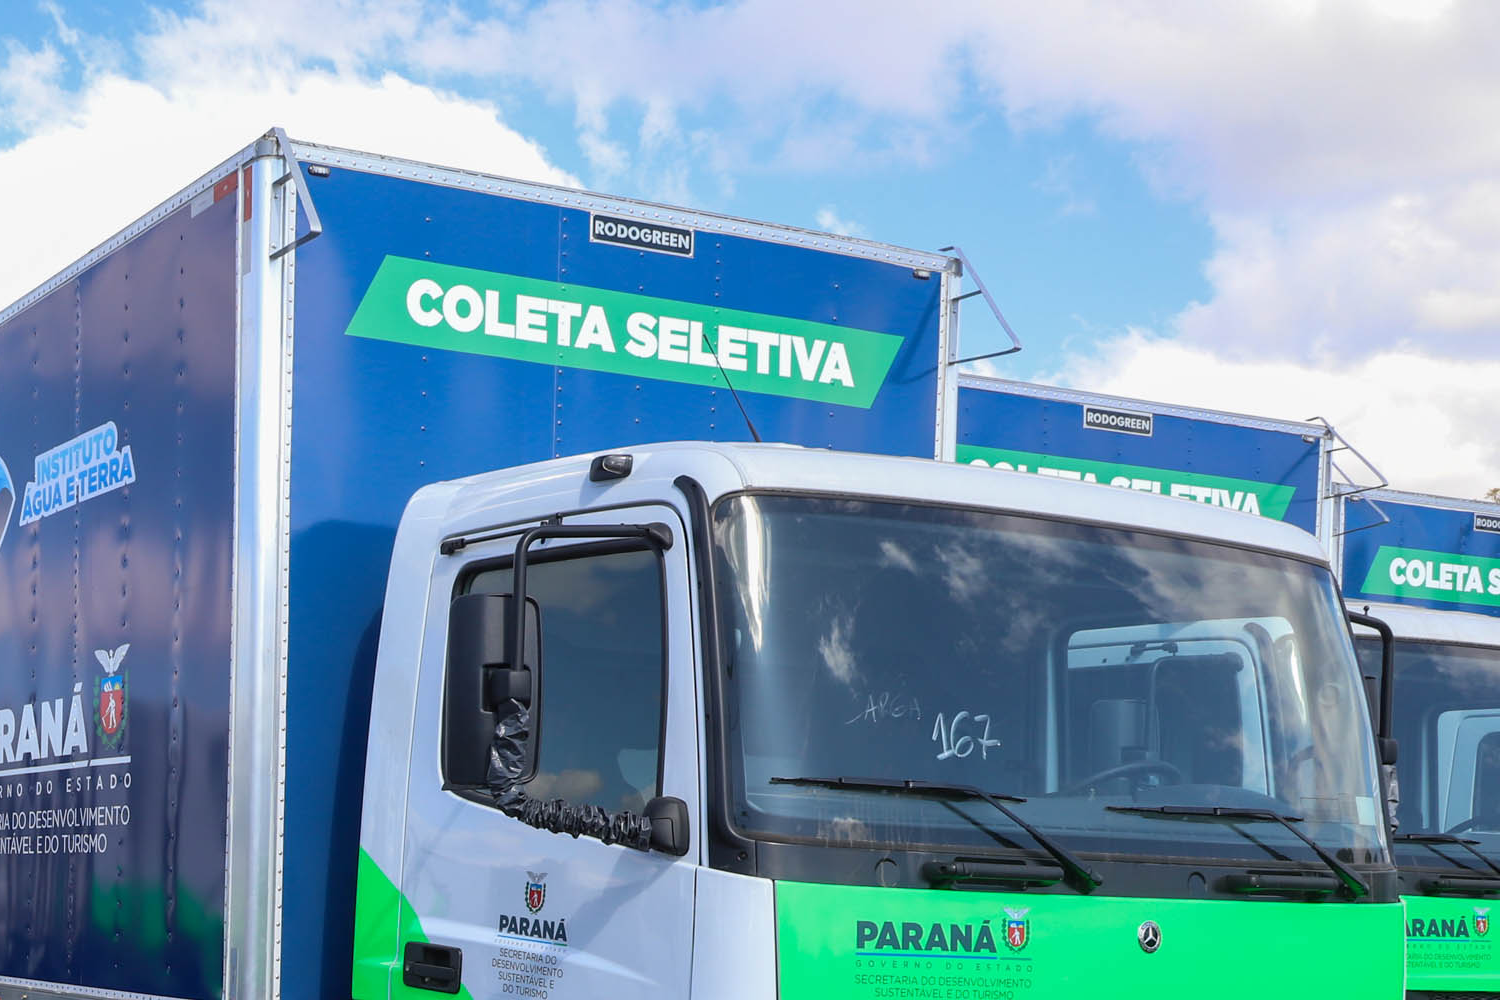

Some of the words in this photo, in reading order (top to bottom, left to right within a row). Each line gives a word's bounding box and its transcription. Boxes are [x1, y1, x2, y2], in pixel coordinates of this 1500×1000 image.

[594, 219, 690, 249] RODOGREEN
[406, 277, 616, 354] COLETA
[624, 311, 855, 388] SELETIVA
[1086, 411, 1150, 431] RODOGREEN
[36, 428, 116, 486] INSTITUTO
[22, 481, 62, 520] ÁGUA
[66, 476, 75, 503] E
[78, 452, 133, 497] TERRA
[1389, 557, 1484, 593] COLETA
[931, 711, 1001, 761] 167
[36, 780, 53, 796] DO
[66, 772, 132, 793] ESTADO
[12, 811, 27, 830] DO
[28, 804, 130, 829] DESENVOLVIMENTO
[36, 835, 43, 854] E
[44, 835, 59, 854] DO
[62, 833, 107, 853] TURISMO
[498, 914, 567, 942] PARANÁ
[856, 919, 998, 953] PARANÁ
[1406, 915, 1470, 938] RANÁ
[499, 947, 543, 961] SECRETARIA
[545, 954, 557, 965] DO
[855, 960, 933, 969] GOVERNO
[945, 961, 964, 970] DO
[975, 963, 1033, 973] ESTADO
[491, 957, 563, 979] DESENVOLVIMENTO
[498, 970, 547, 988] SUSTENTÁVEL
[549, 979, 555, 989] E
[502, 983, 514, 994] DO
[516, 985, 548, 1000] TURISMO
[854, 974, 918, 986] SECRETARIA
[921, 975, 936, 986] DO
[938, 976, 1032, 989] DESENVOLVIMENTO
[946, 988, 954, 999] E
[955, 989, 970, 999] DO
[972, 989, 1014, 1000] TURISMO
